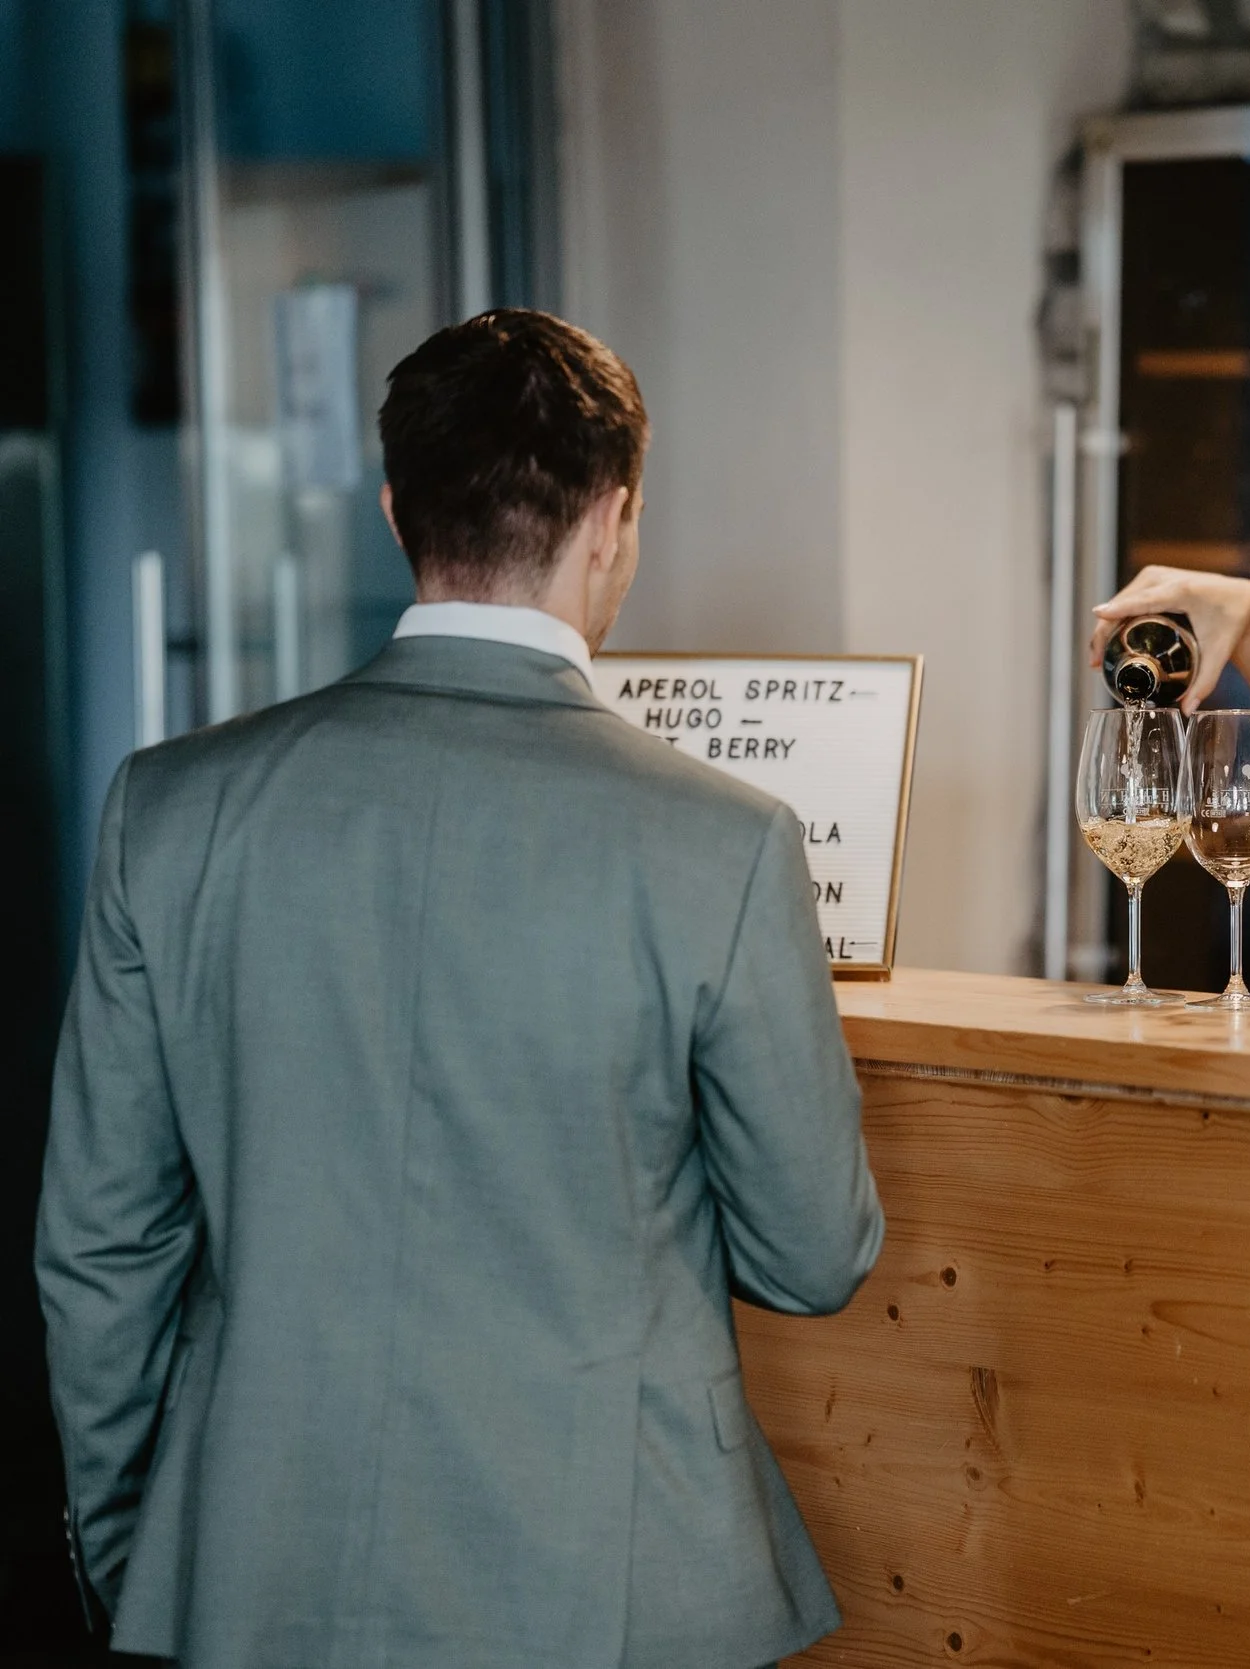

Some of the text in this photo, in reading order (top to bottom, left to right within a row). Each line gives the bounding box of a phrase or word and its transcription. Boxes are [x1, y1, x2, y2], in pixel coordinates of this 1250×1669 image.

[618, 679, 844, 701] APEROL SPRITZ
[645, 708, 722, 728] HUGO
[708, 738, 796, 759] BERRY
